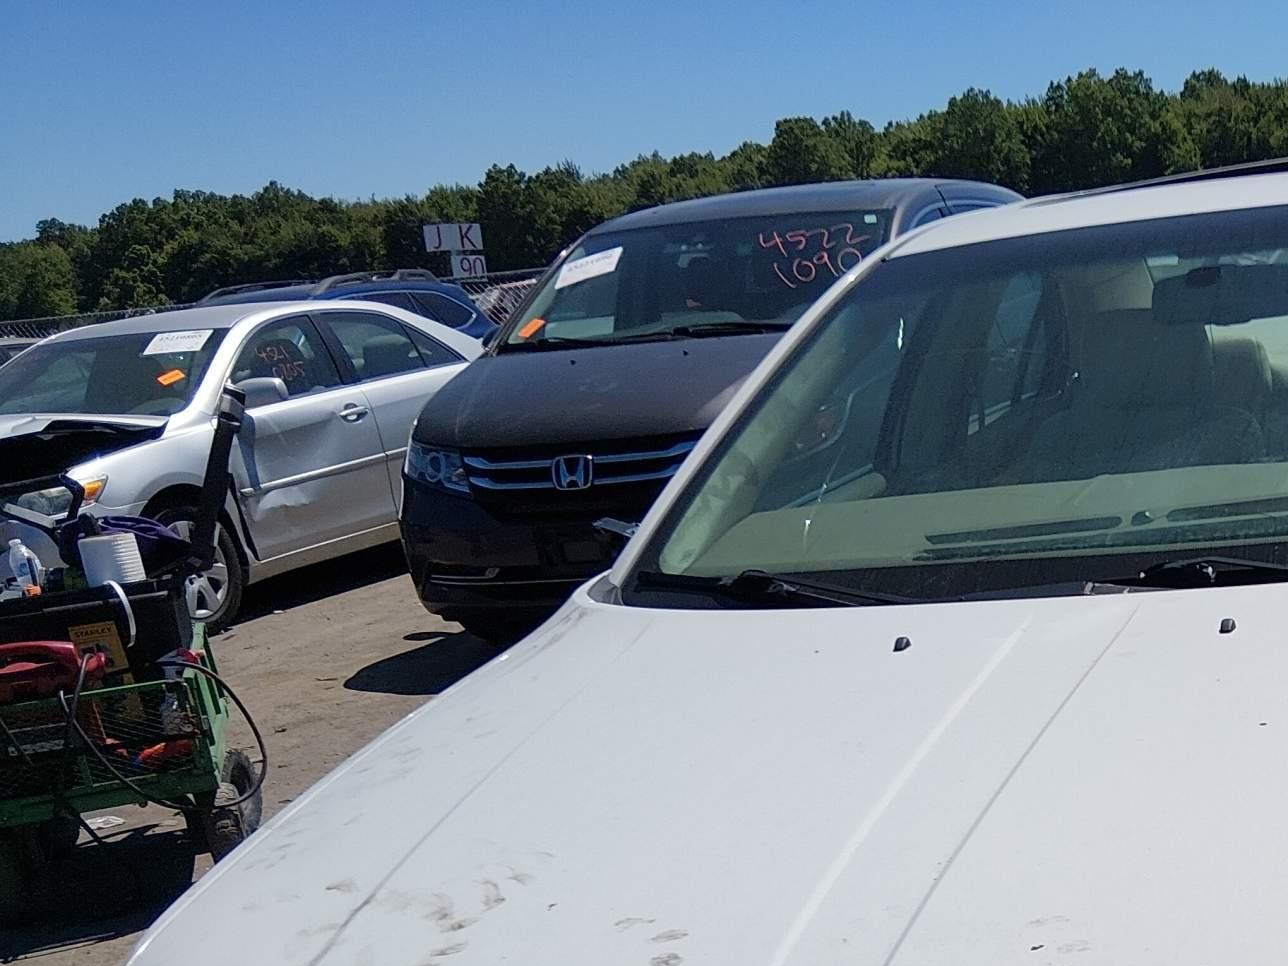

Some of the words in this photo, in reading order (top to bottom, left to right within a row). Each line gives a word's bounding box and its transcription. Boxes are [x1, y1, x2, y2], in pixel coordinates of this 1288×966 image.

[433, 226, 442, 249] J
[458, 225, 479, 248] K
[759, 223, 872, 257] 4522
[773, 247, 863, 289] 1090
